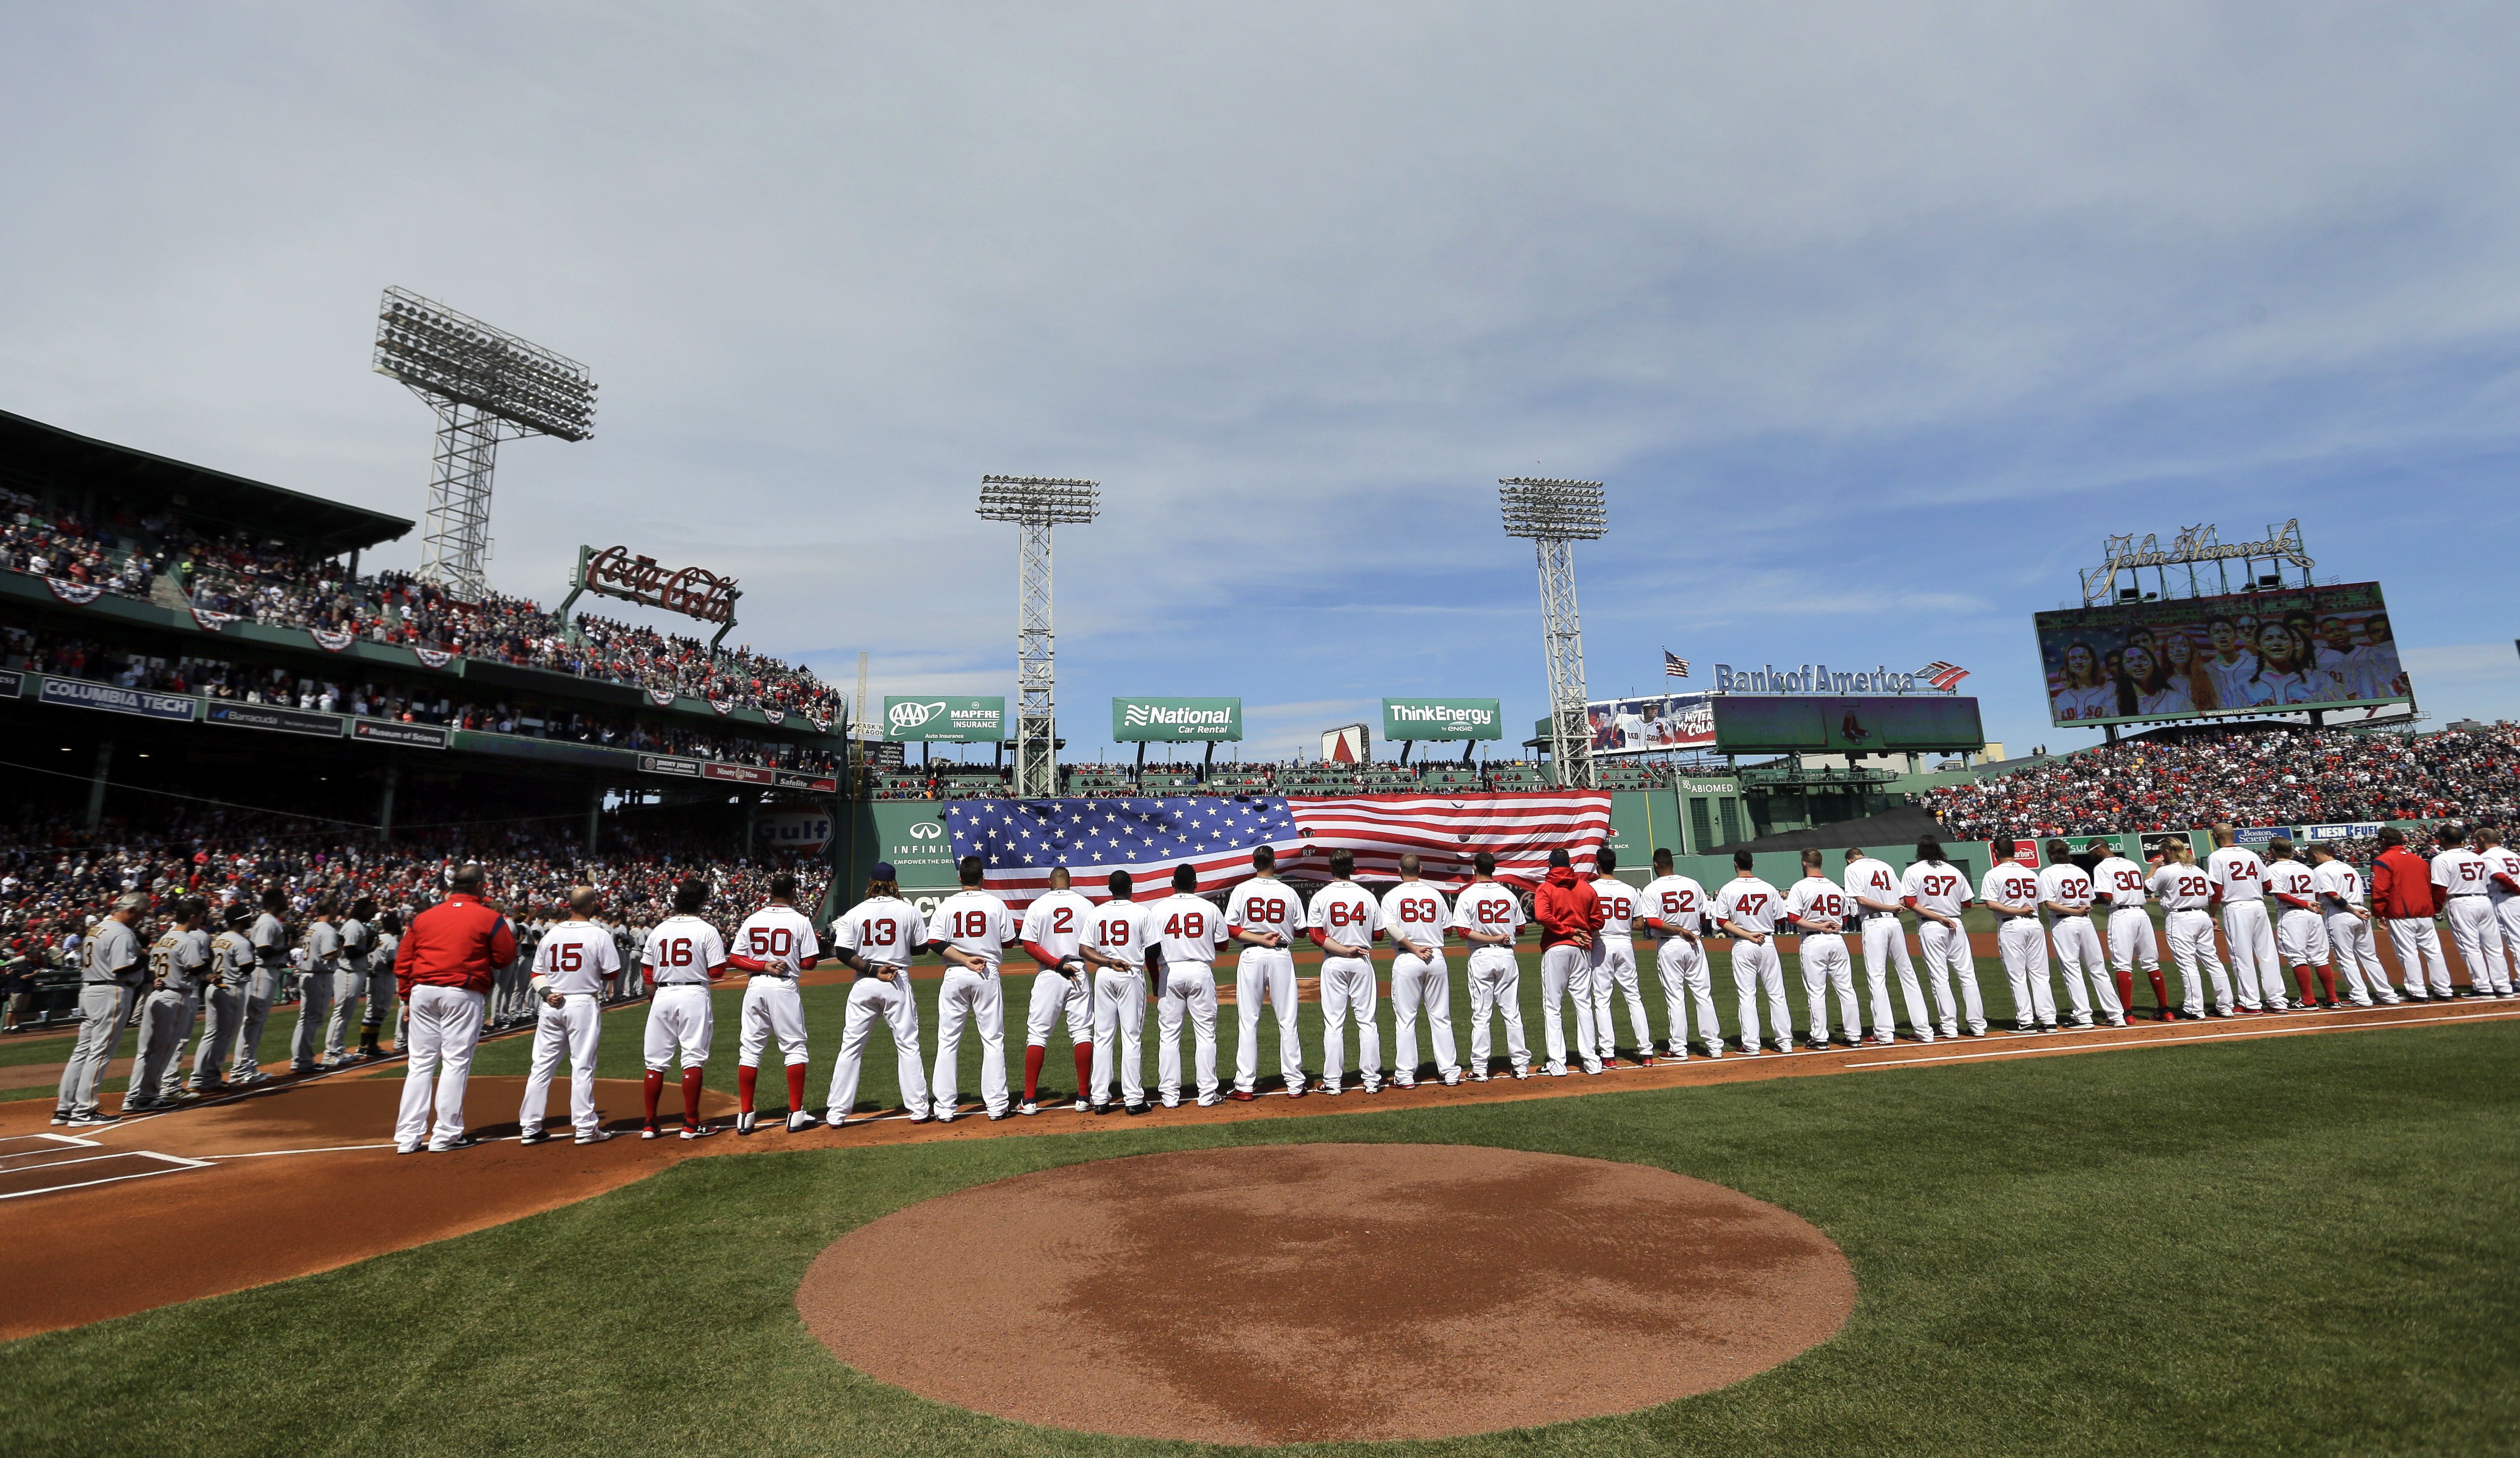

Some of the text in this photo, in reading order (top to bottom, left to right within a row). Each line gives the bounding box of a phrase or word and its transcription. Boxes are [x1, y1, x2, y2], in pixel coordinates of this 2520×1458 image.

[2084, 518, 2315, 600] John Hancock
[587, 545, 738, 622] Coca-Cola
[1713, 664, 1916, 692] Bank of America
[45, 681, 188, 713] COLUMBIA TECH
[229, 711, 277, 725] Barracuda
[893, 703, 925, 726] AAA
[951, 710, 1000, 719] MAPFRE
[1150, 707, 1231, 724] National
[1390, 705, 1492, 725] ThinkEnergy
[1698, 712, 1714, 724] TEA
[2062, 708, 2076, 721] ED
[369, 728, 440, 743] Museum of Science
[1687, 722, 1715, 736] COLO
[717, 768, 735, 777] Ninety
[780, 778, 807, 787] Safelite
[1691, 784, 1733, 792] ABIOMED
[753, 819, 828, 839] Gulf
[2239, 833, 2282, 843] Scientif
[2317, 826, 2378, 838] NESN FUEL
[894, 845, 952, 853] INFINIT
[2013, 851, 2034, 860] arbors
[2229, 861, 2258, 881] 24
[2459, 862, 2485, 881] 57
[2502, 858, 2520, 875] 5
[1871, 870, 1891, 891] 41
[1924, 875, 1957, 896] 37
[2006, 878, 2036, 899] 35
[2061, 879, 2090, 899] 32
[2114, 870, 2143, 891] 30
[2178, 876, 2207, 897] 28
[2289, 874, 2313, 894] 12
[2343, 873, 2355, 892] 7
[1246, 897, 1286, 923] 68
[1400, 898, 1436, 923] 63
[1478, 900, 1510, 923] 62
[1598, 897, 1631, 920] 56
[1661, 890, 1695, 914] 52
[1736, 894, 1768, 915] 47
[1811, 894, 1842, 916] 46
[953, 911, 986, 938] 18
[1053, 907, 1073, 934] 2
[1330, 902, 1366, 926] 64
[862, 918, 896, 946] 13
[1099, 919, 1129, 946] 19
[1165, 912, 1204, 939] 48
[749, 927, 791, 956] 50
[550, 943, 583, 972] 15
[659, 938, 692, 967] 16
